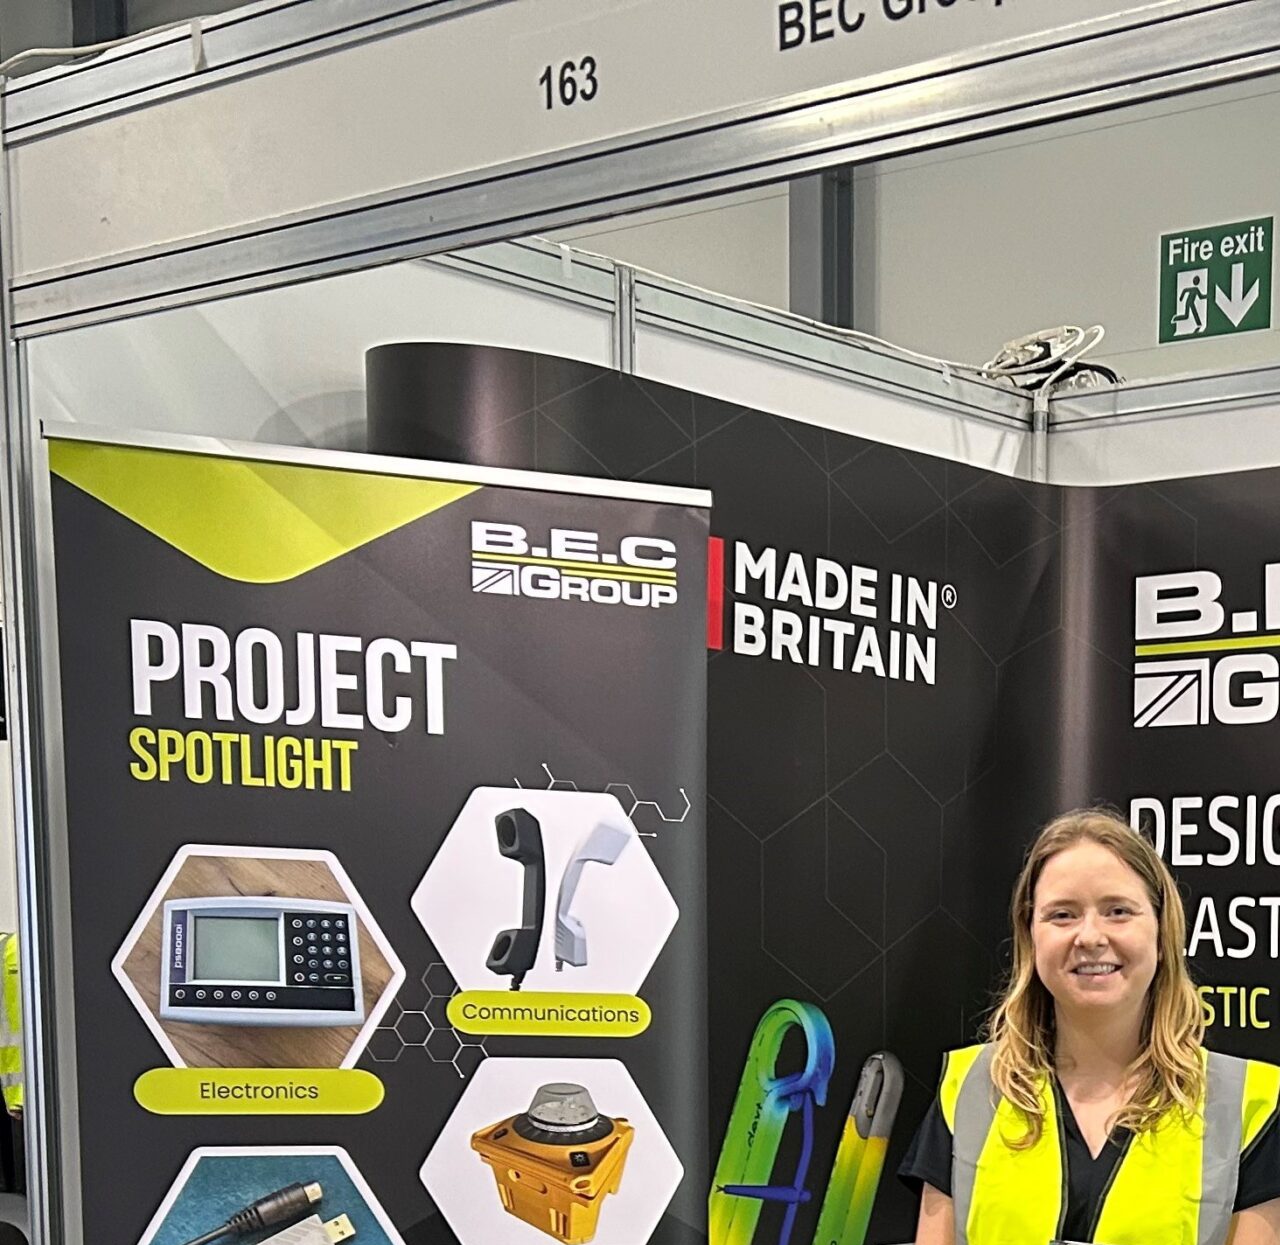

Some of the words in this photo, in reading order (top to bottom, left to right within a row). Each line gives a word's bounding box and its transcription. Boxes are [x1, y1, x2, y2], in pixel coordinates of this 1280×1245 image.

[779, 0, 866, 51] BEC
[539, 56, 598, 109] 163
[1168, 237, 1213, 267] Fire
[1219, 226, 1264, 257] exit
[471, 522, 677, 568] B.E.C
[520, 566, 677, 608] GROUP
[735, 541, 877, 618] MADE
[734, 602, 936, 685] BRITAIN
[130, 618, 457, 737] PROJECT
[129, 727, 359, 792] SPOTLIGHT
[462, 1002, 640, 1024] Communications
[1196, 986, 1270, 1029] STIC
[199, 1081, 319, 1101] Electronics
